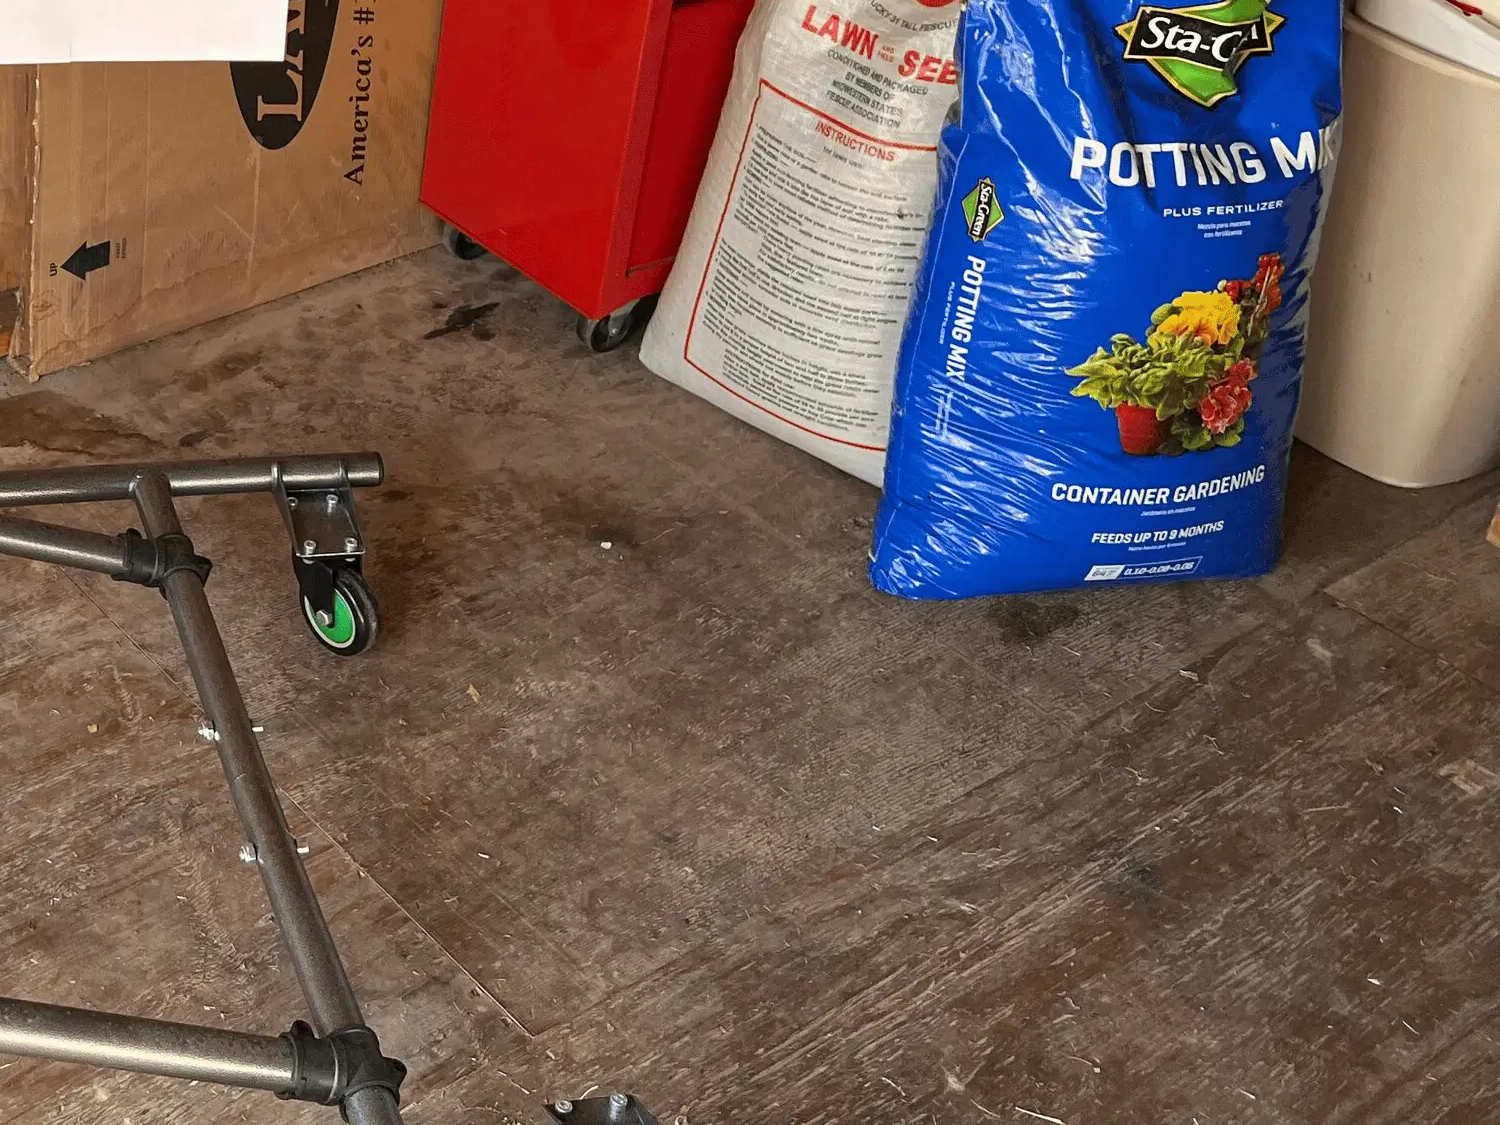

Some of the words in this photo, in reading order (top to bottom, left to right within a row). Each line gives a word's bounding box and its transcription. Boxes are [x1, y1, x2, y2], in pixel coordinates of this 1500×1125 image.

[802, 4, 879, 60] LAWN
[902, 19, 918, 32] TALL
[827, 49, 871, 76] CONDITIONED
[871, 69, 884, 83] AND
[883, 75, 929, 96] PACKAGED
[898, 50, 958, 85] SEE
[832, 79, 871, 106] MIDWESTERN
[871, 99, 903, 116] STATES
[856, 75, 883, 98] MEMBERS
[883, 89, 896, 101] OF
[344, 35, 375, 186] America's
[825, 90, 852, 112] FESCUE
[851, 101, 901, 129] ASSOCIATION
[815, 120, 896, 163] INSTRUCTIONS
[1070, 136, 1266, 188] POTTING
[972, 183, 992, 237] Sta-Green
[1163, 206, 1202, 218] PLUS
[1206, 199, 1284, 216] FERTILIZER
[49, 262, 58, 277] UP
[951, 254, 986, 344] POTTING
[946, 342, 969, 382] MIX
[1051, 482, 1171, 506] CONTAINER
[1173, 465, 1266, 503] GARDENING
[1091, 532, 1133, 544] FEEDS
[1133, 531, 1151, 544] UP
[1152, 530, 1170, 542] TO
[1169, 529, 1178, 540] 9
[1178, 520, 1225, 539] MONTHS
